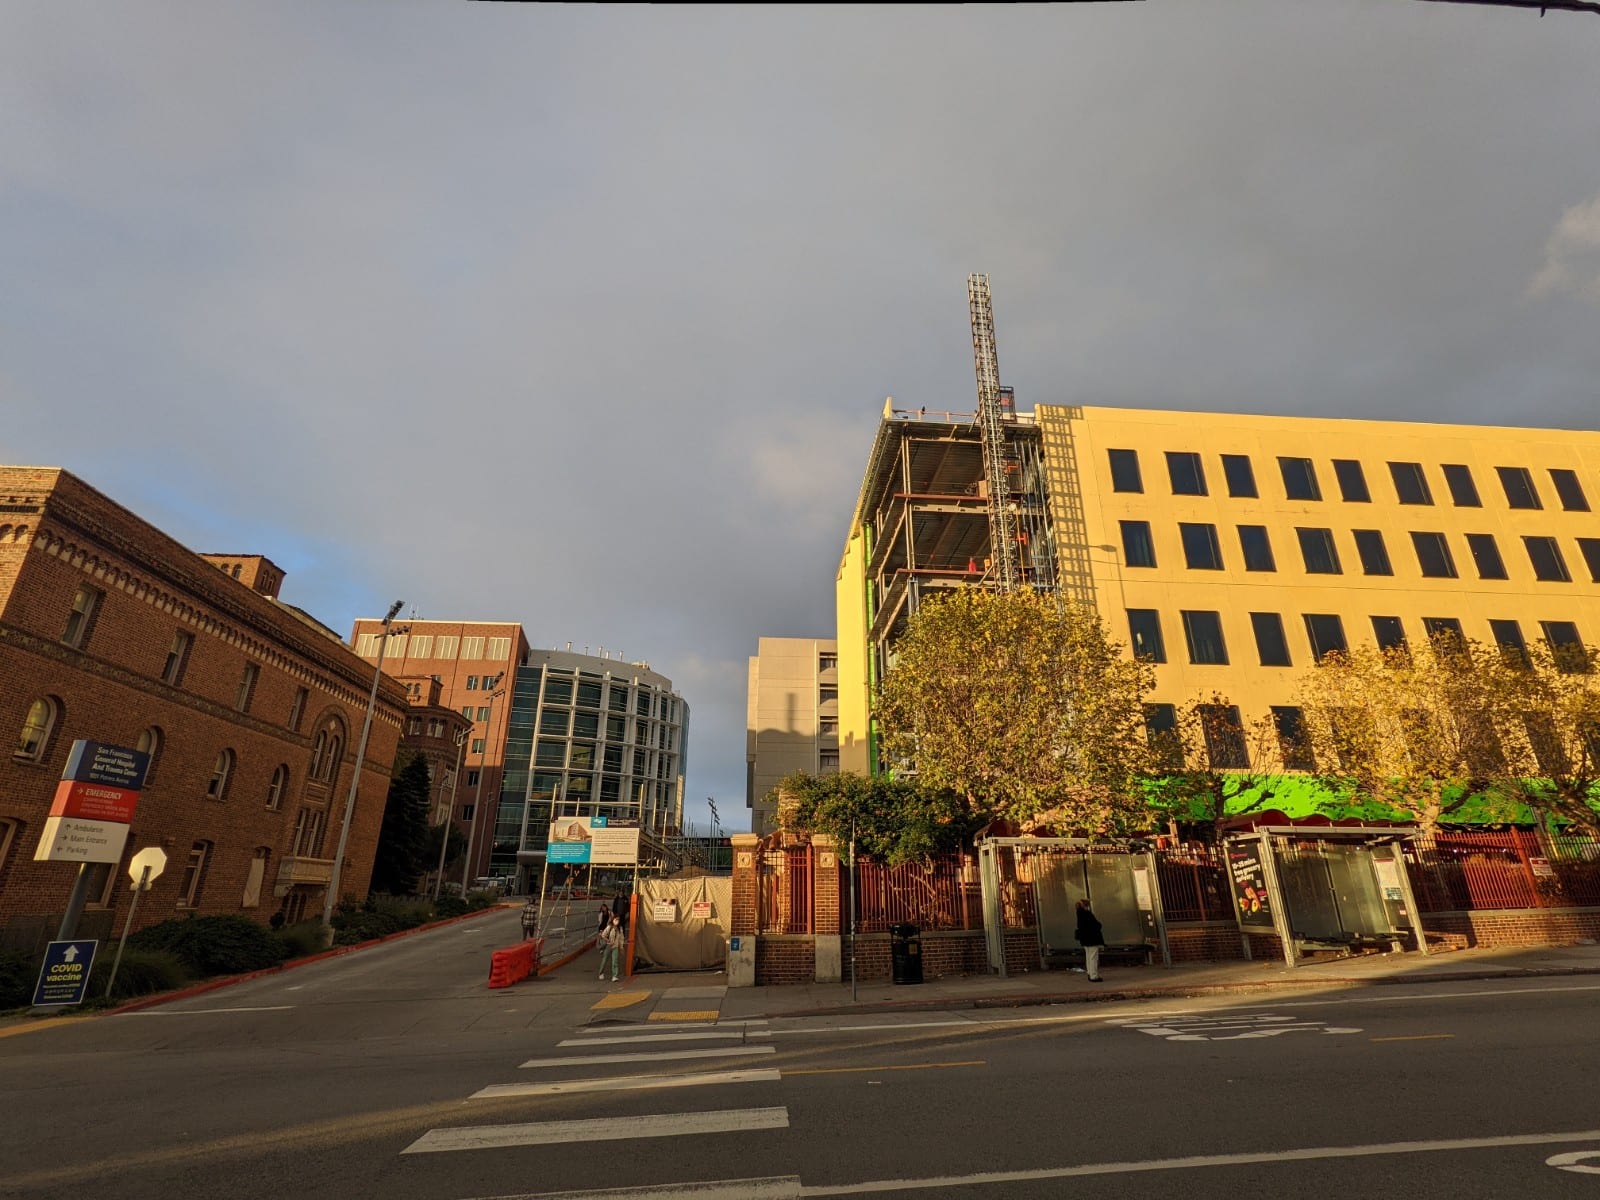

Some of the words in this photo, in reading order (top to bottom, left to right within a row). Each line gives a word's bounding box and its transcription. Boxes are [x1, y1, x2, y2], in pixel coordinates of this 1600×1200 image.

[97, 746, 109, 755] San
[95, 754, 117, 765] General
[92, 762, 105, 771] And
[85, 788, 122, 800] EMERGENCY
[73, 824, 104, 833] Ambulance
[85, 836, 107, 845] Entrance
[66, 846, 89, 855] Parking
[1243, 864, 1261, 876] grocery
[1236, 873, 1254, 883] delivery
[51, 963, 82, 973] COVID
[46, 973, 82, 982] vaccine
